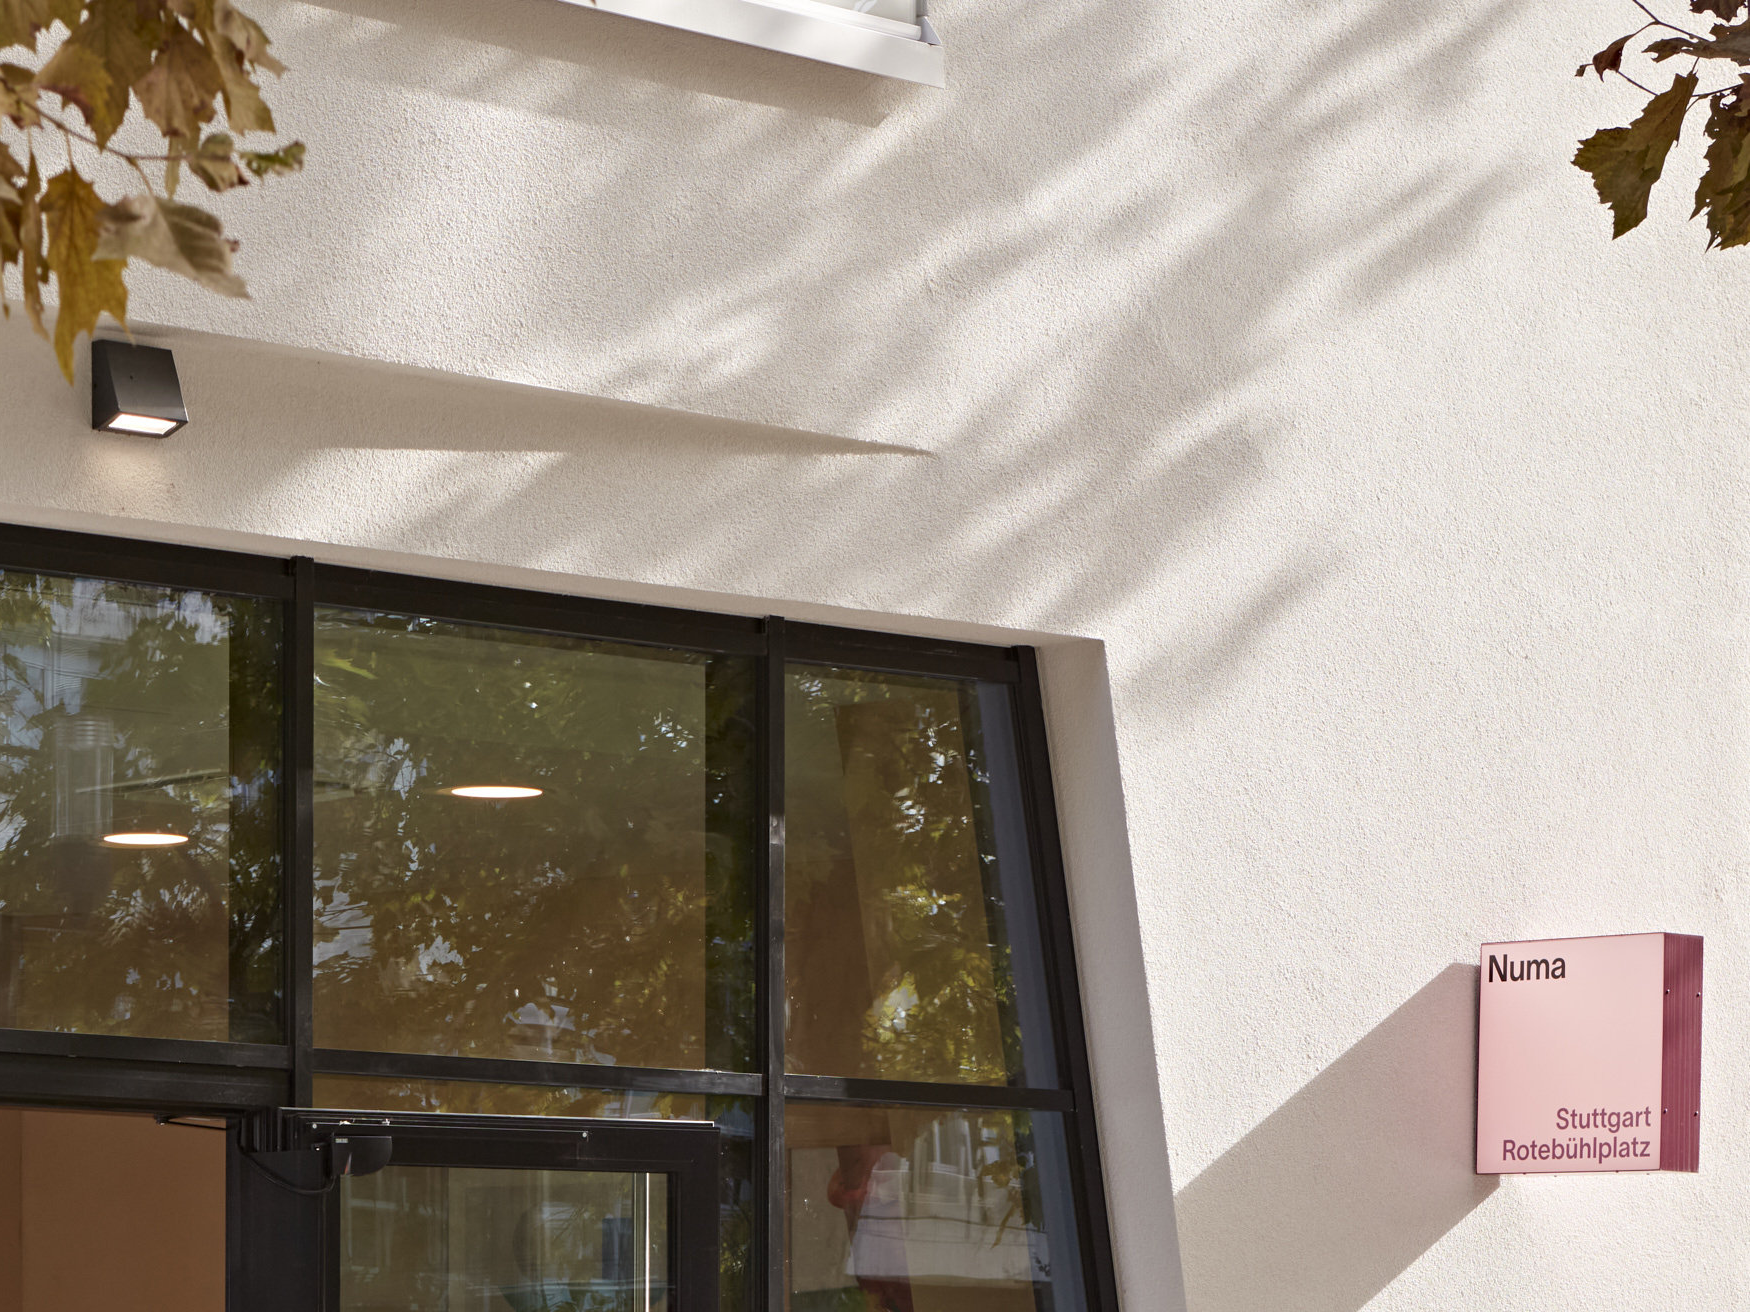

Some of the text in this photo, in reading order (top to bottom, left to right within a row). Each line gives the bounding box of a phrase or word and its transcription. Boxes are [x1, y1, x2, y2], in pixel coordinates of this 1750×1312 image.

[1488, 953, 1566, 983] Numa
[1555, 1106, 1652, 1133] Stuttgart
[1502, 1136, 1651, 1164] Rotebühlplatz
